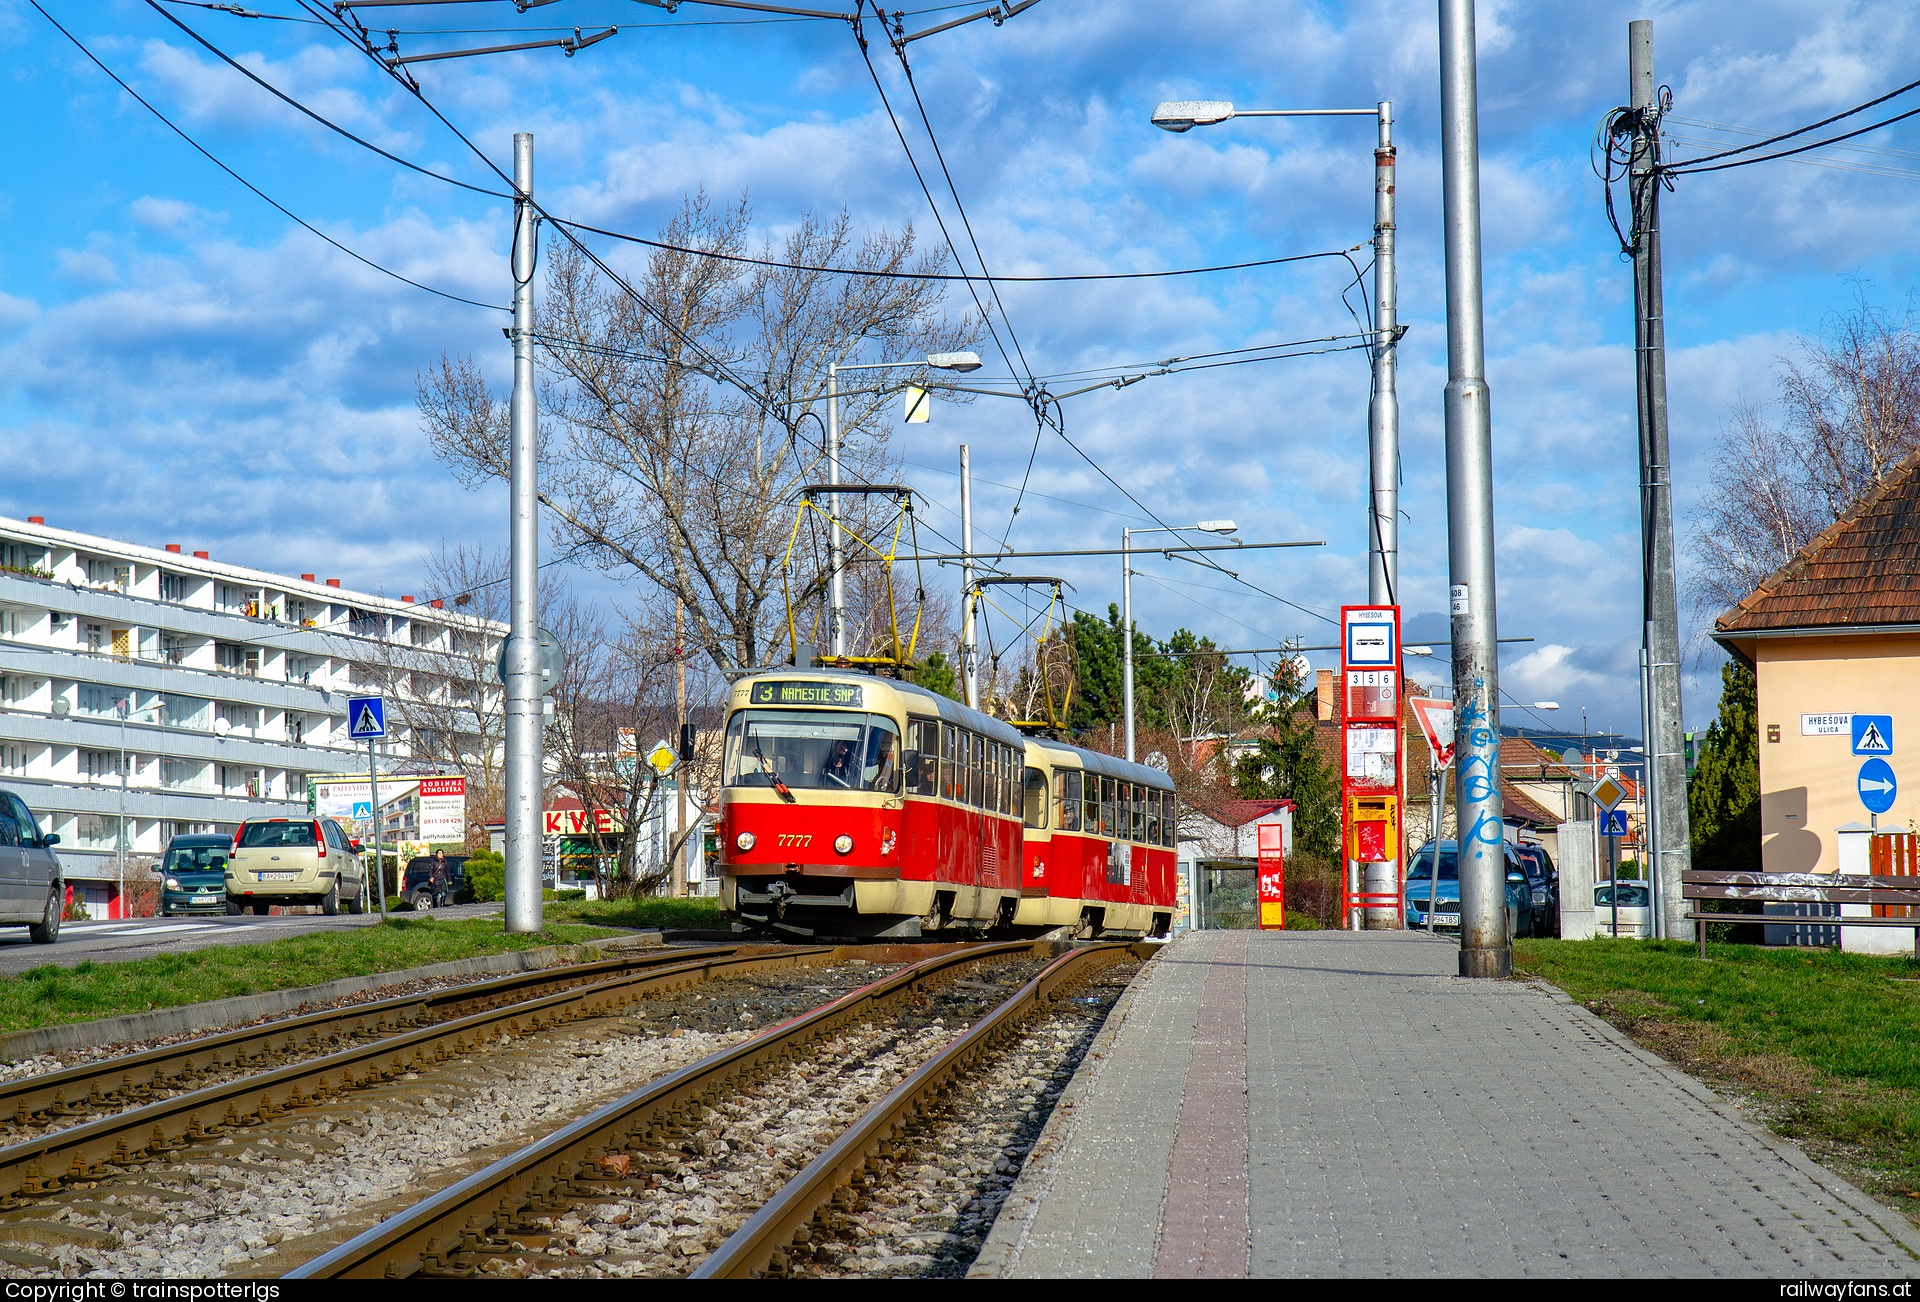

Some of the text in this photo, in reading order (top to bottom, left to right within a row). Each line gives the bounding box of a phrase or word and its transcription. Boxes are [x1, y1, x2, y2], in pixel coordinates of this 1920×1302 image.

[1452, 603, 1461, 611] 46
[1353, 674, 1389, 684] 3 5 6
[733, 689, 750, 698] 7777
[760, 685, 773, 702] 3
[781, 687, 830, 701] NAMESTIE
[1808, 715, 1848, 725] HYBEŠOVA
[778, 834, 813, 848] 7777
